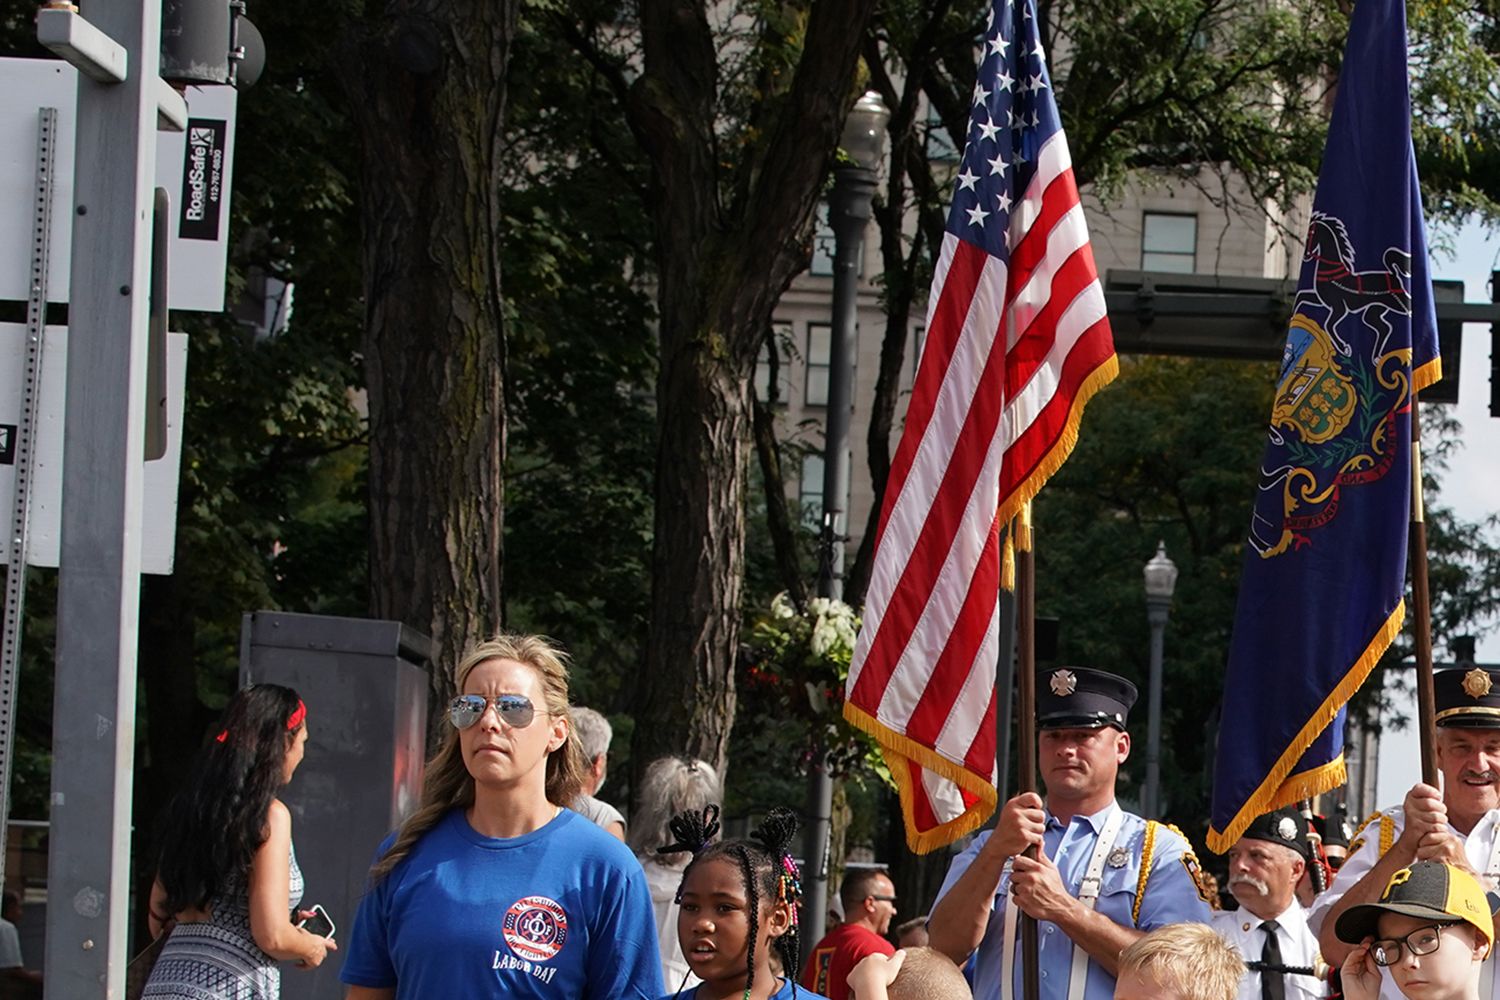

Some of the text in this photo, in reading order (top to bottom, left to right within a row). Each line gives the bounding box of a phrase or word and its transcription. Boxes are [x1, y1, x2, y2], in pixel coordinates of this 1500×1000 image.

[186, 146, 206, 220] RoadSafe
[1382, 868, 1412, 900] P
[492, 950, 557, 985] LABOR DAY
